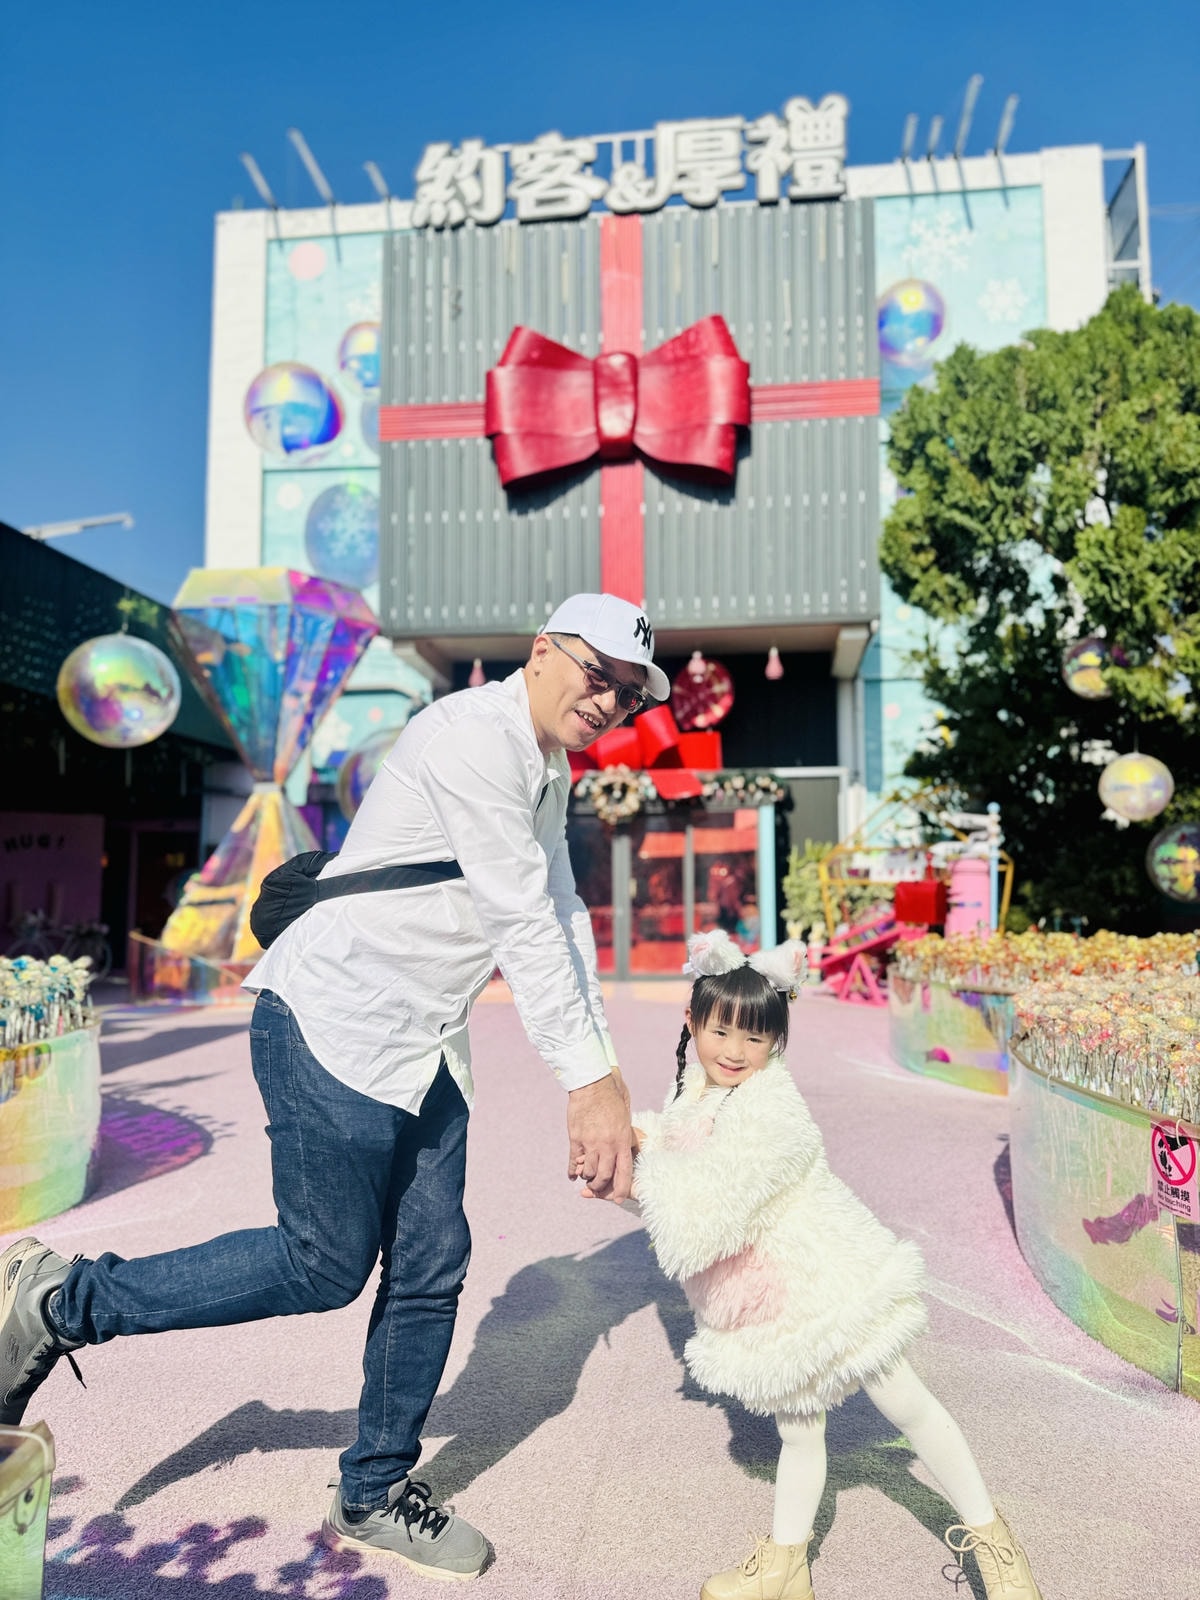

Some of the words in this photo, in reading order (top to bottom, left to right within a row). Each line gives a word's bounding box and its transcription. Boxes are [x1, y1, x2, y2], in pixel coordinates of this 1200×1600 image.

[411, 94, 848, 231] 約客&厚禮
[633, 616, 652, 650] NY
[1157, 1180, 1191, 1203] 禁止觸摸
[1165, 1196, 1191, 1213] touching
